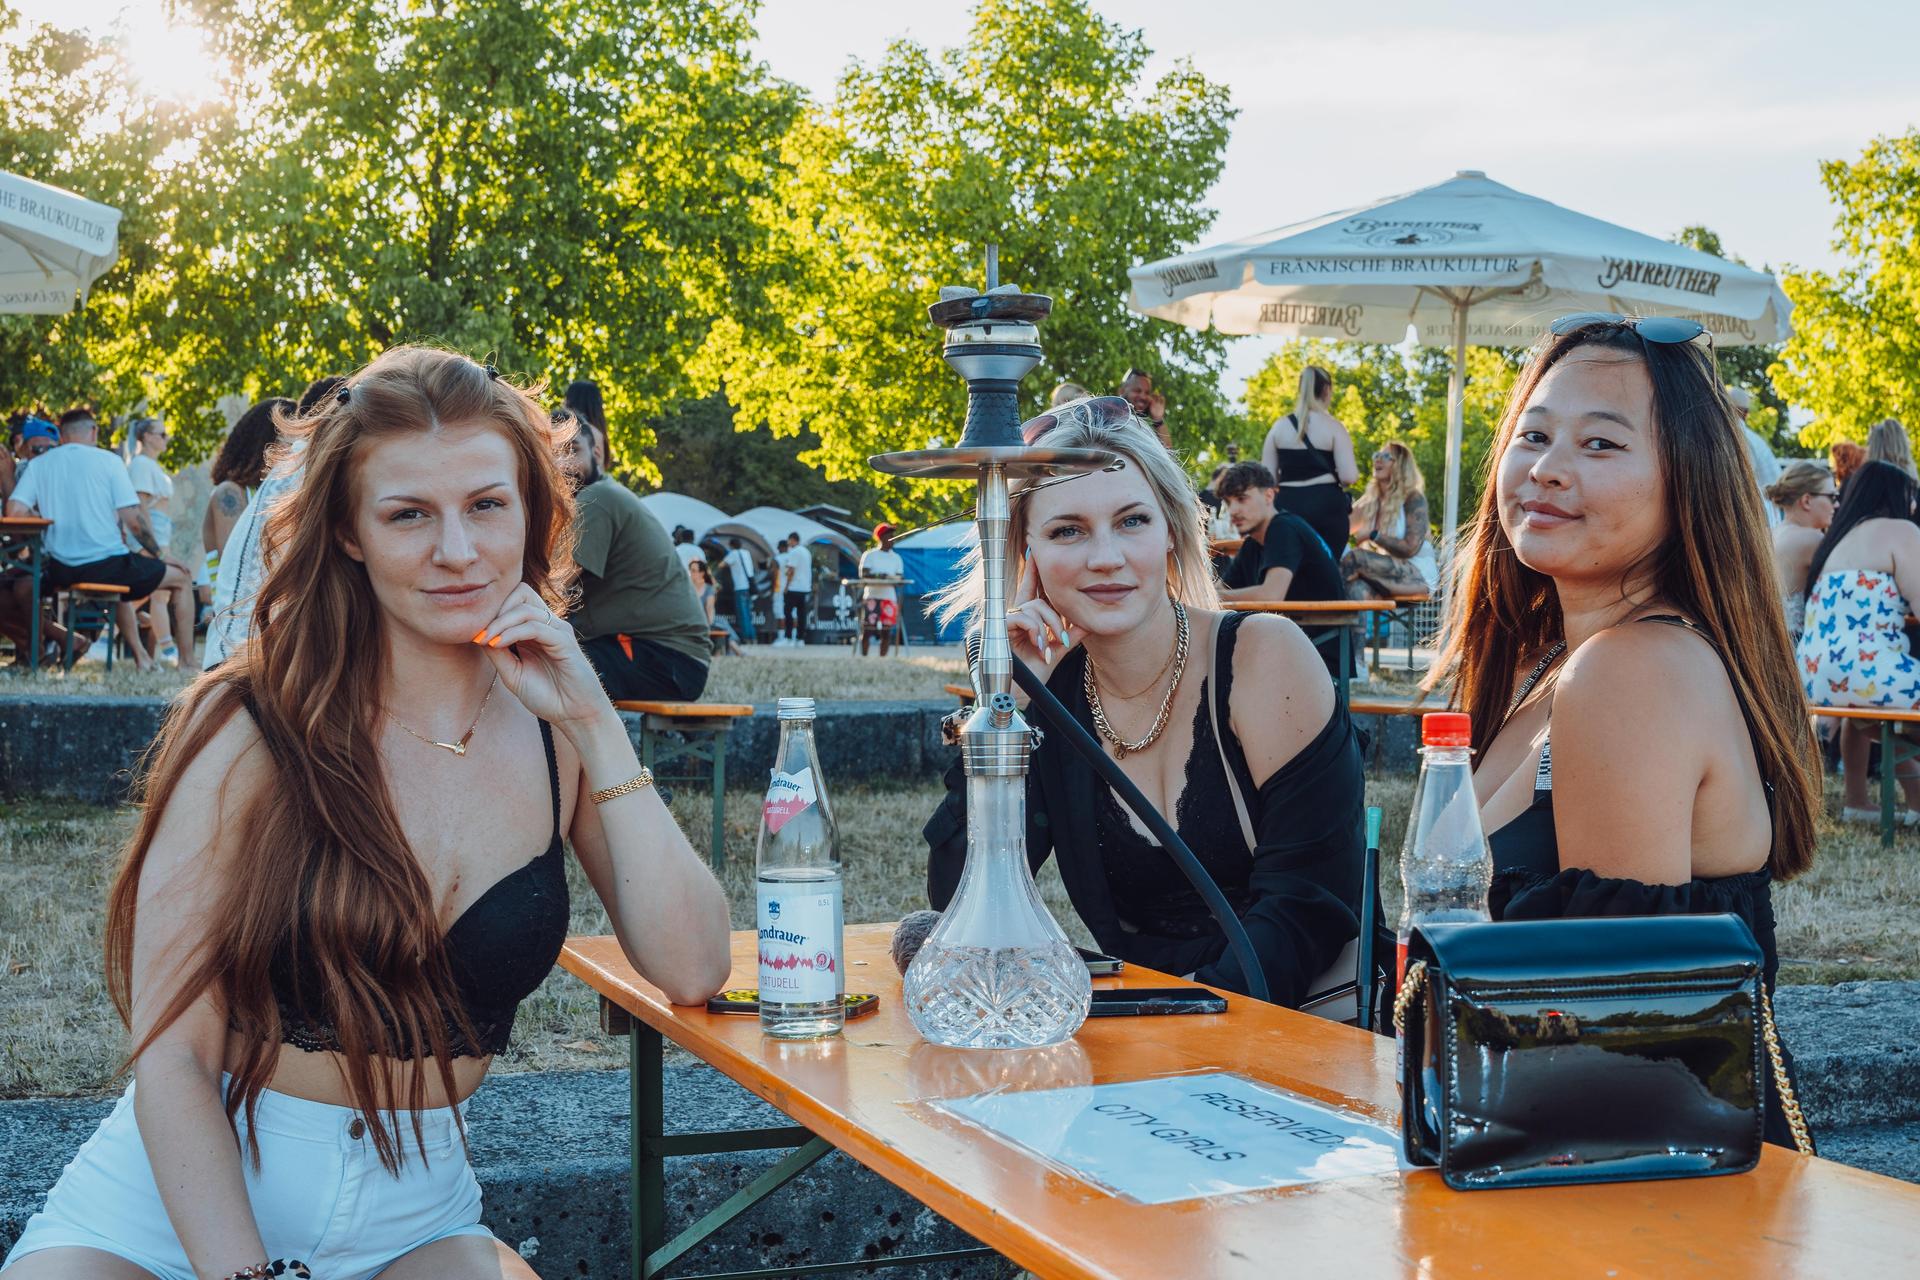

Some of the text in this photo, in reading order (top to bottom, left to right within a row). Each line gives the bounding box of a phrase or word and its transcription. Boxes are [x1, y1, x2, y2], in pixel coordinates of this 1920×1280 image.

[19, 197, 105, 242] BRAUKULTUR
[1270, 257, 1519, 275] FRÄNKISCHE BRAUKULTUR
[1598, 256, 1722, 297] BAYREUTHER
[758, 925, 806, 945] ondrauer
